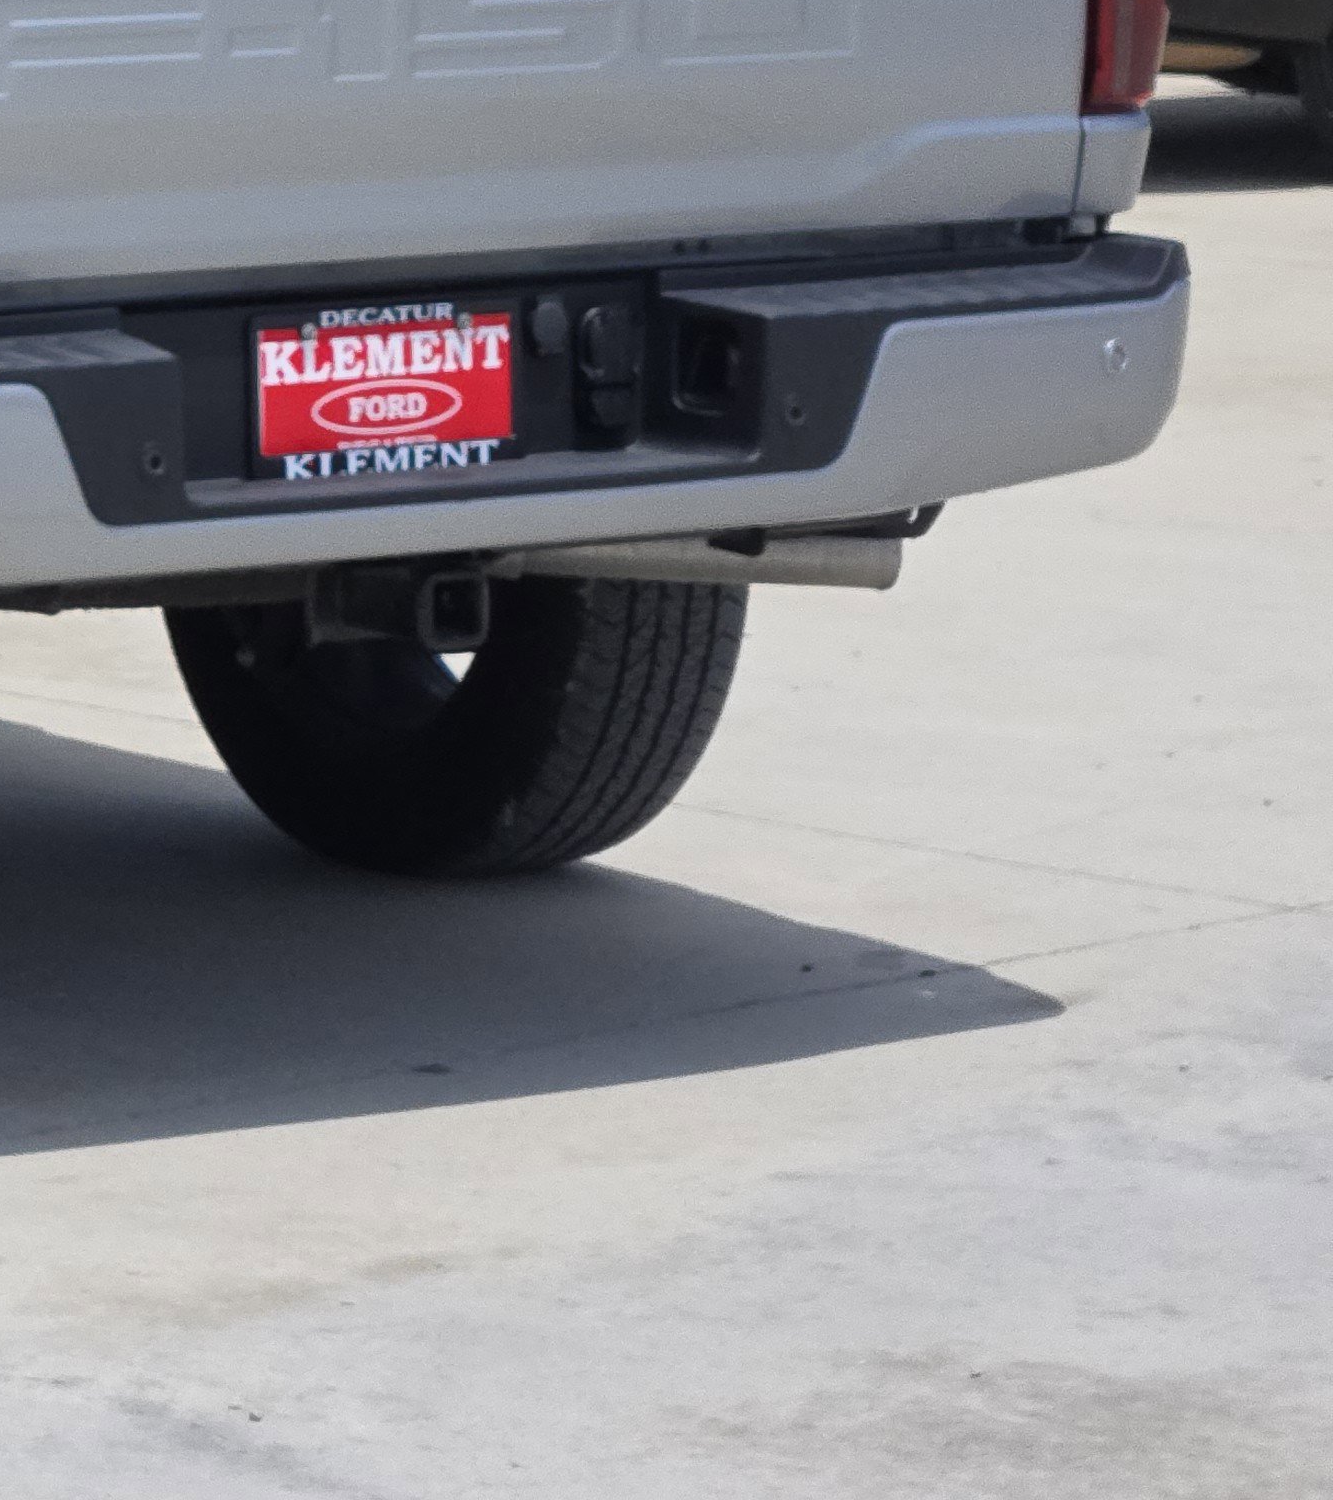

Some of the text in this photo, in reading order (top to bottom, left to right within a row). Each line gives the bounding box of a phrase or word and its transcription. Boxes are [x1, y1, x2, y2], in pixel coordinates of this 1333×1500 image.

[319, 302, 454, 328] DECATUR
[259, 324, 510, 386] KLEMENT
[348, 392, 427, 423] FORD
